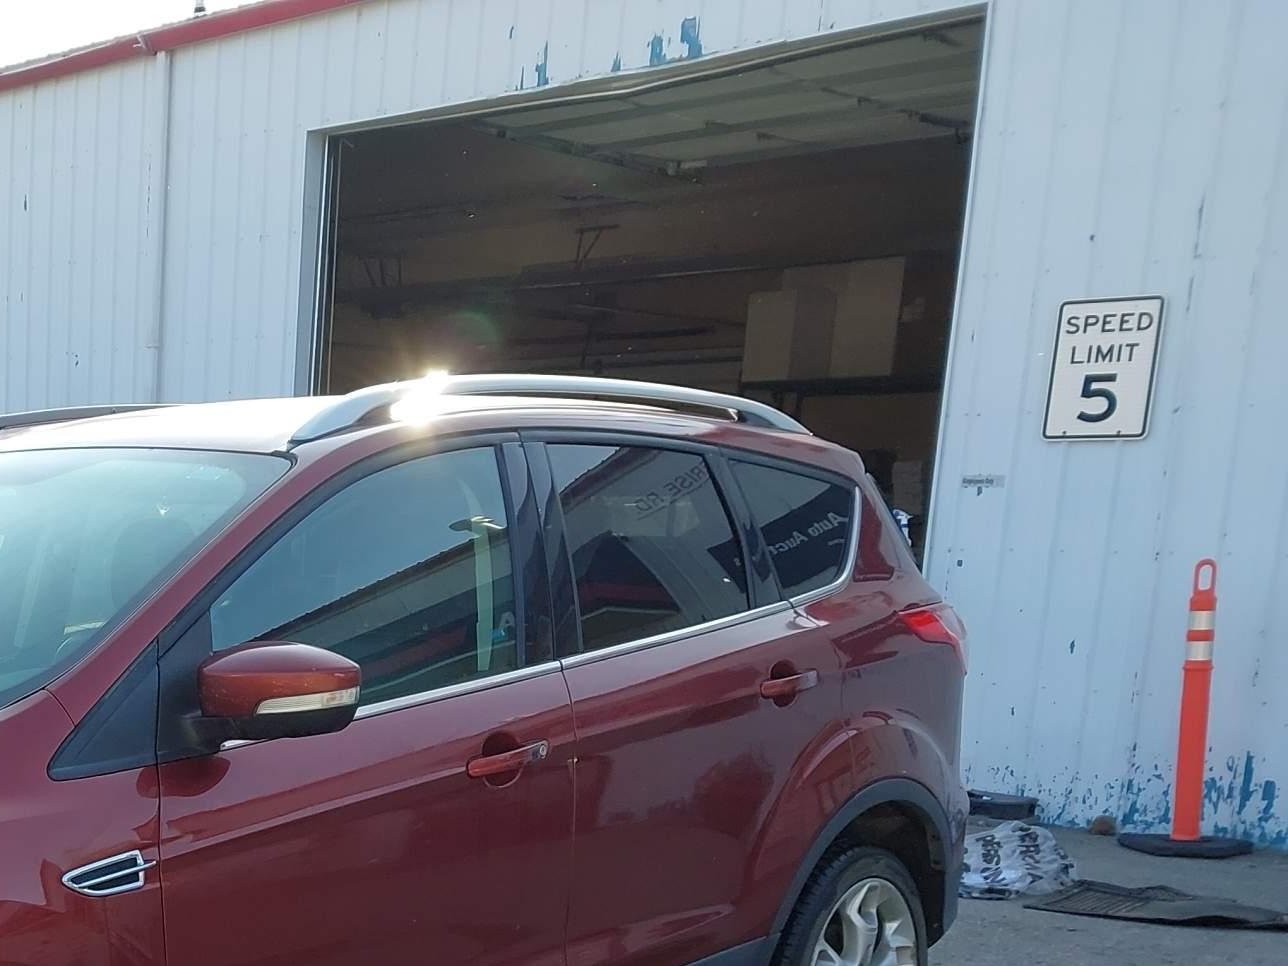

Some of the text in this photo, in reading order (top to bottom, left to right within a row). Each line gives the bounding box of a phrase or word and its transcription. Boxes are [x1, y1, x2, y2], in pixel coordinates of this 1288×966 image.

[1065, 311, 1154, 335] SPEED
[1069, 342, 1140, 365] LIMIT
[1076, 373, 1118, 423] 5
